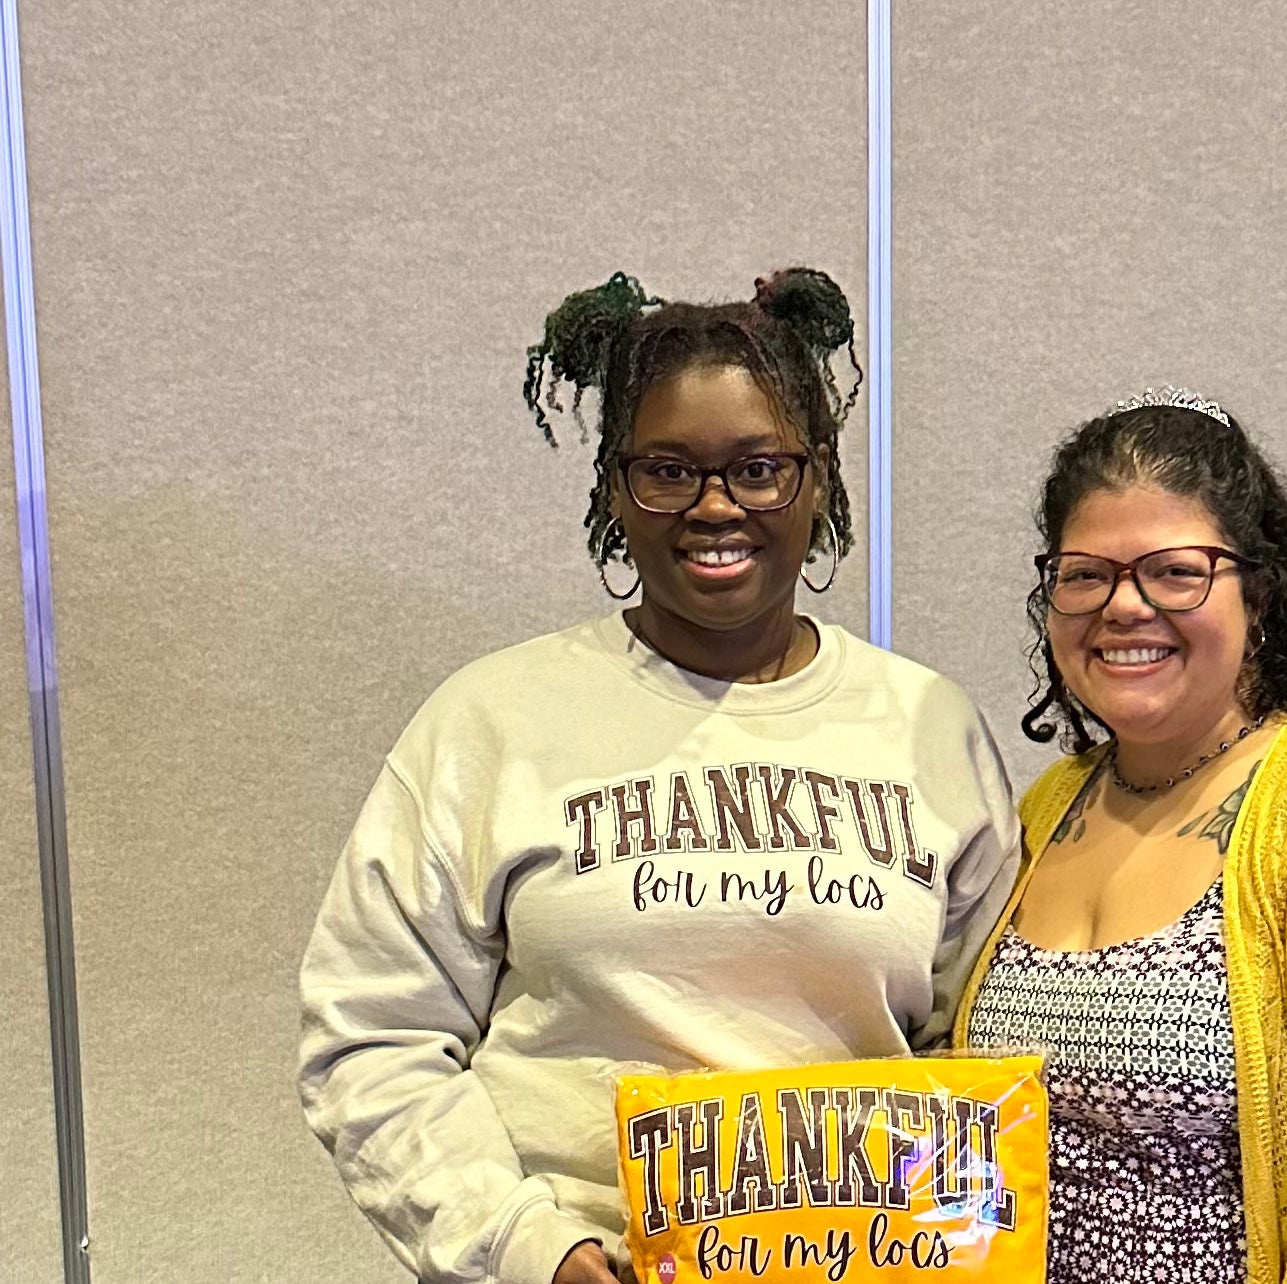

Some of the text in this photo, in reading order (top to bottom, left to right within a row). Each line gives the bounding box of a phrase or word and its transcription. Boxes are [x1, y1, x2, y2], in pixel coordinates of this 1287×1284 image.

[564, 762, 938, 889] THANKFUL
[633, 856, 888, 916] for my locs
[628, 1087, 1017, 1238] THANKFUL
[697, 1213, 955, 1282] for my locs
